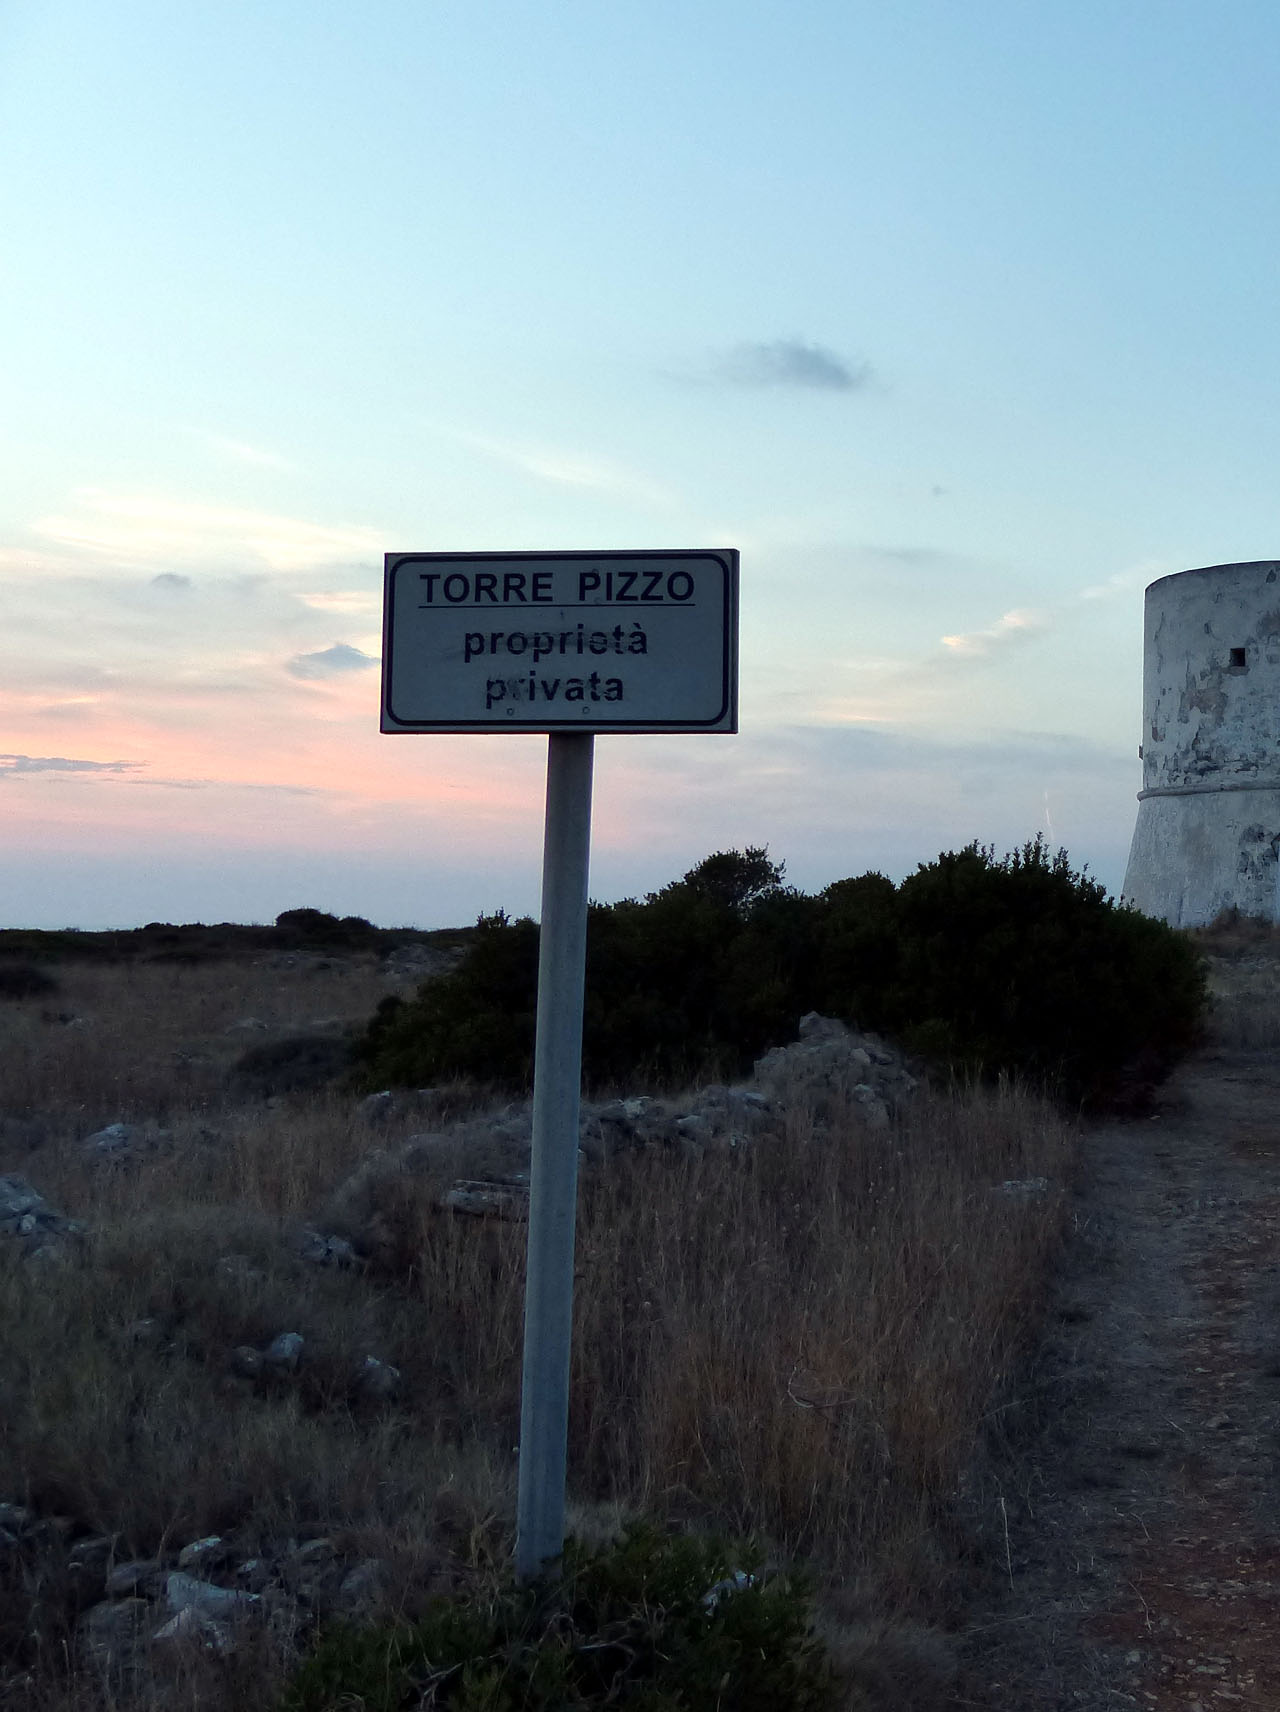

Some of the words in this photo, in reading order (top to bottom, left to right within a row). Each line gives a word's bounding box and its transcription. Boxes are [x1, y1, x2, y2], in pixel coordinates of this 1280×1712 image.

[419, 573, 554, 603] TORRE
[578, 571, 695, 602] PIZZO
[464, 622, 648, 663] proprietà
